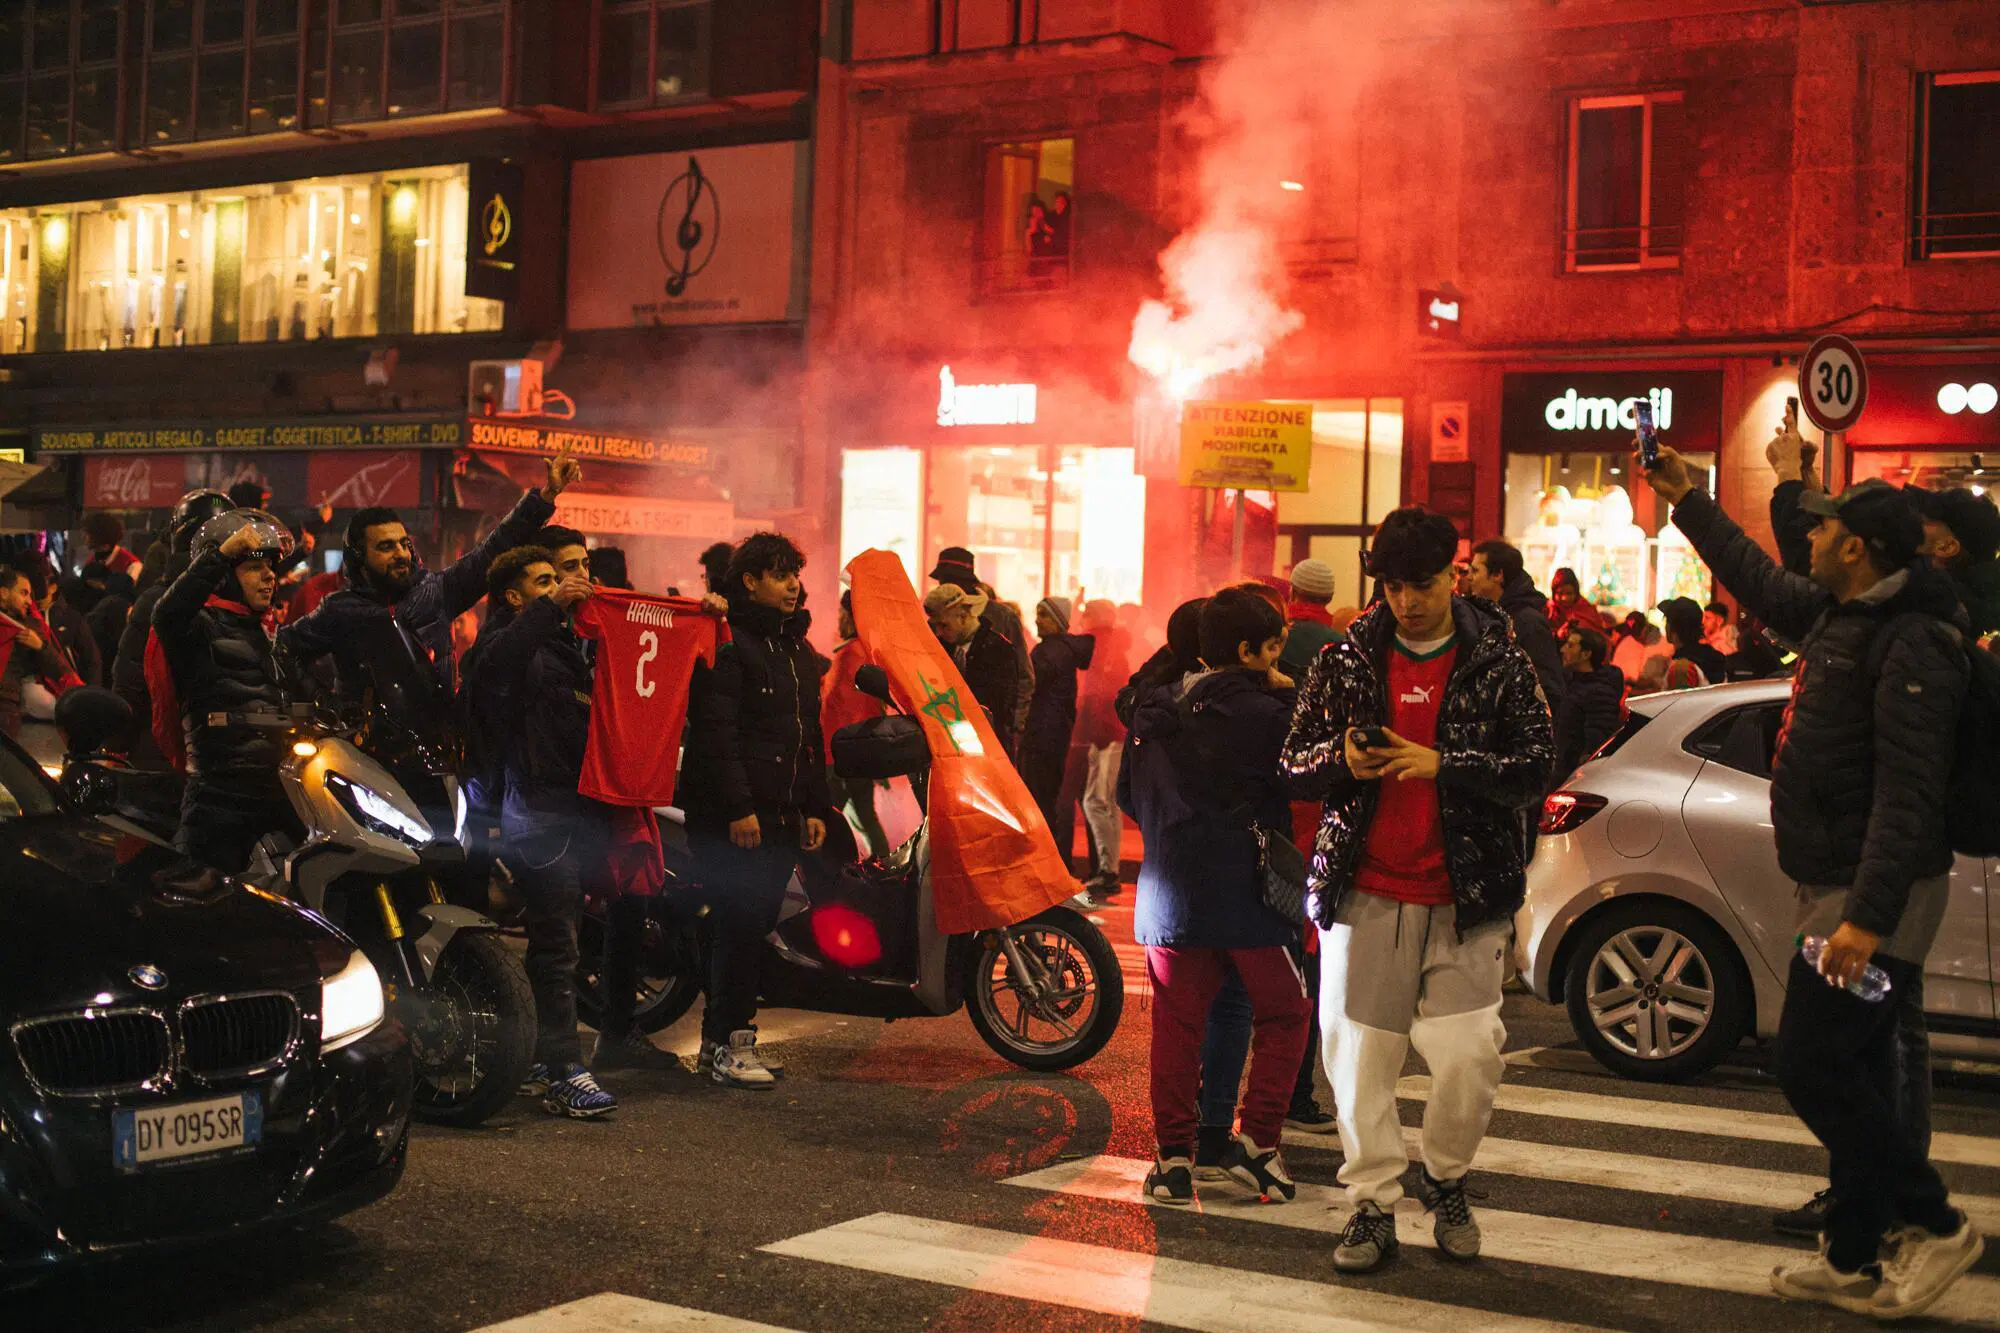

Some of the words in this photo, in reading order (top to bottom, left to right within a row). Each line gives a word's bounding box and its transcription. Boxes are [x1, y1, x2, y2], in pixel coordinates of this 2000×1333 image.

[1817, 361, 1853, 405] 30
[1190, 407, 1305, 425] ATTENZIONE
[41, 432, 95, 448] SOUVENIR
[104, 431, 153, 448] ARTICOLI
[156, 429, 203, 447] REGALO
[216, 428, 266, 446] GADGET
[273, 426, 361, 445] OGGETTISTICA
[371, 425, 421, 443] T-SHIRT
[431, 424, 460, 442] DVD
[472, 424, 539, 448] SOUVENIR
[604, 437, 654, 459] REGALO
[1202, 440, 1288, 455] MODIFICATA
[636, 630, 658, 697] 2
